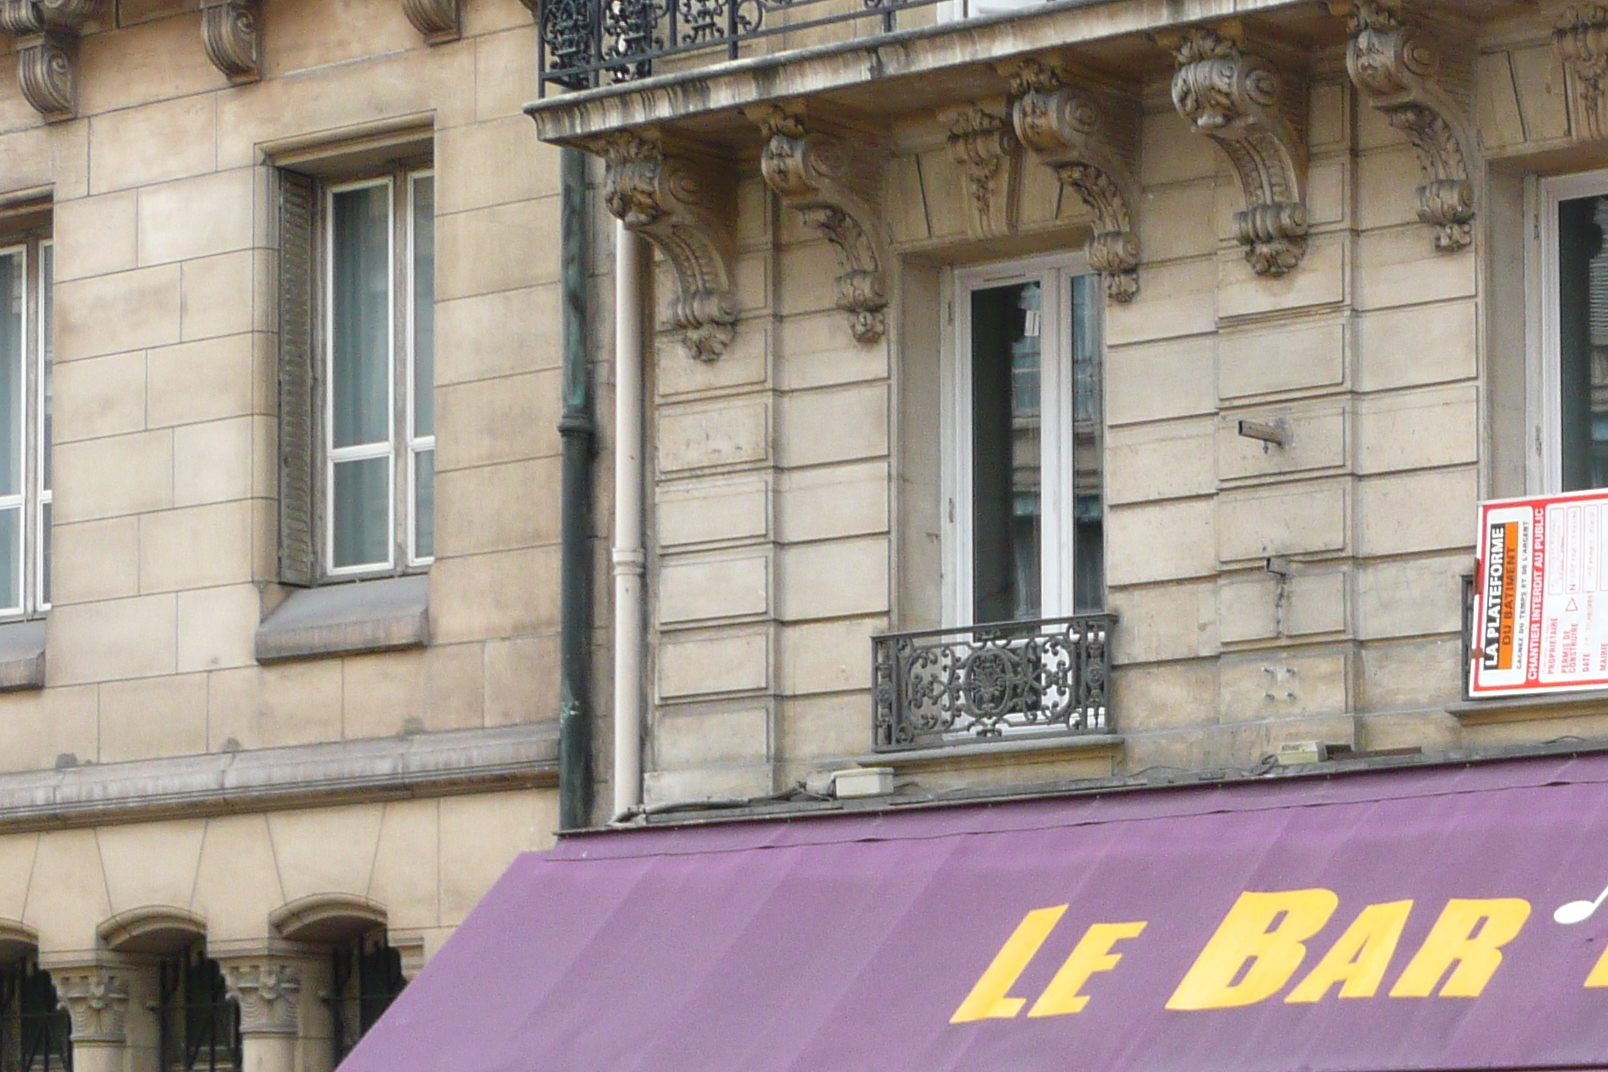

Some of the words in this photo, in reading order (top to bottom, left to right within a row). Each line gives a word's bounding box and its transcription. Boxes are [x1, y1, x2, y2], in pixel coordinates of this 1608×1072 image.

[1534, 508, 1545, 550] PUBLIC
[1521, 564, 1528, 575] DE
[1534, 552, 1544, 568] AU
[1487, 527, 1504, 638] PLATEFORME
[1521, 578, 1528, 588] ET
[1519, 592, 1527, 619] TEMPS
[1531, 570, 1543, 621] INTERDIT
[1502, 625, 1512, 645] DU
[1518, 622, 1525, 634] DU
[1562, 630, 1571, 641] DE
[1485, 643, 1499, 667] LA
[1528, 623, 1540, 679] CHANTIER
[1561, 643, 1571, 674] PERMIS
[1569, 623, 1579, 674] CONSTRUIRE
[1599, 643, 1608, 672] MAIRIE
[1582, 653, 1590, 673] DATE
